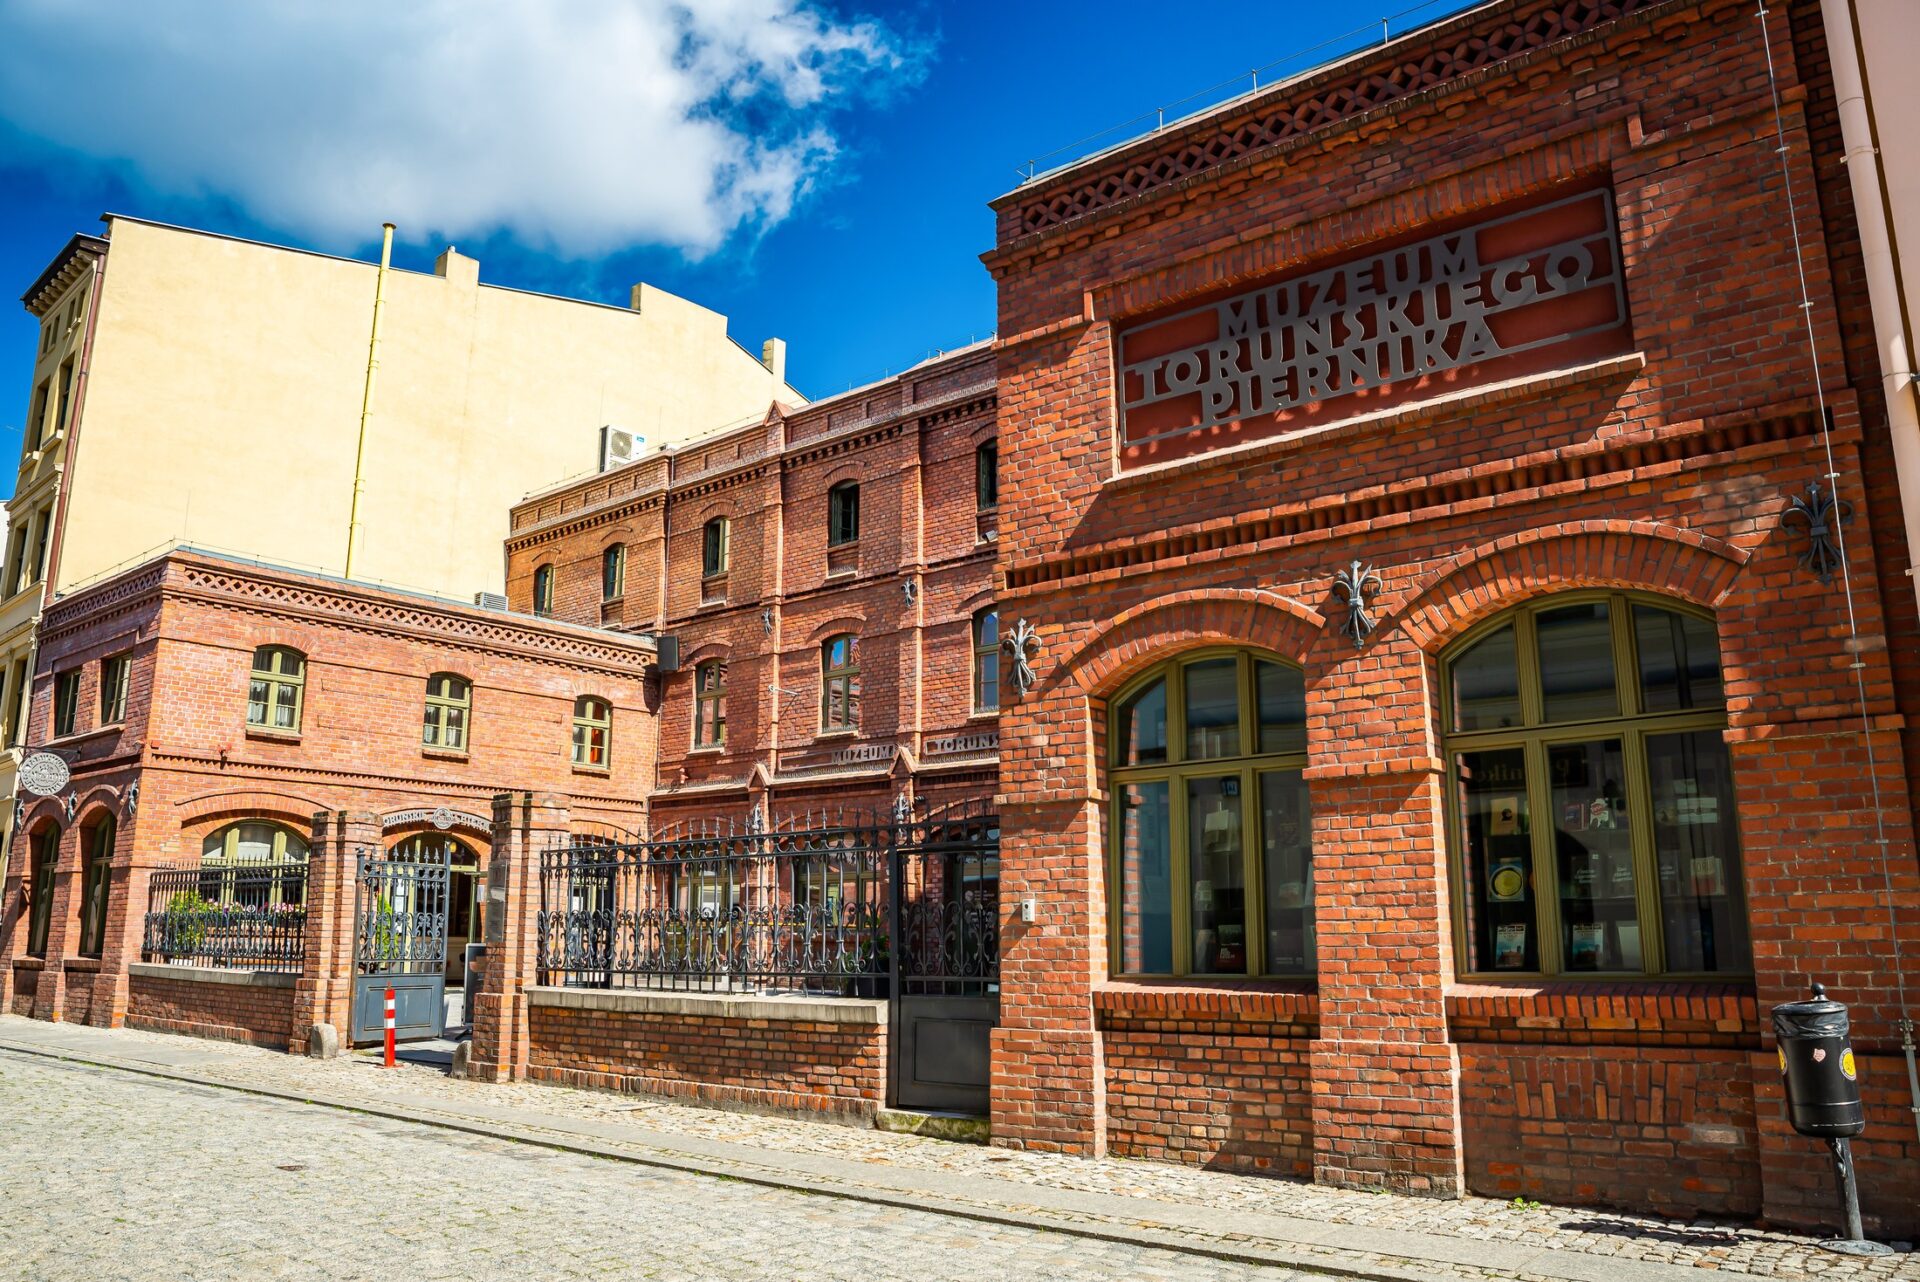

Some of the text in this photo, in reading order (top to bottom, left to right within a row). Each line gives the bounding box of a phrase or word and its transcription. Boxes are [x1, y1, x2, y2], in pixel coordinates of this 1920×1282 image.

[1217, 230, 1480, 339] MUZEUM
[1203, 313, 1503, 422] PIERNIKA
[831, 744, 890, 765] MUZEUM
